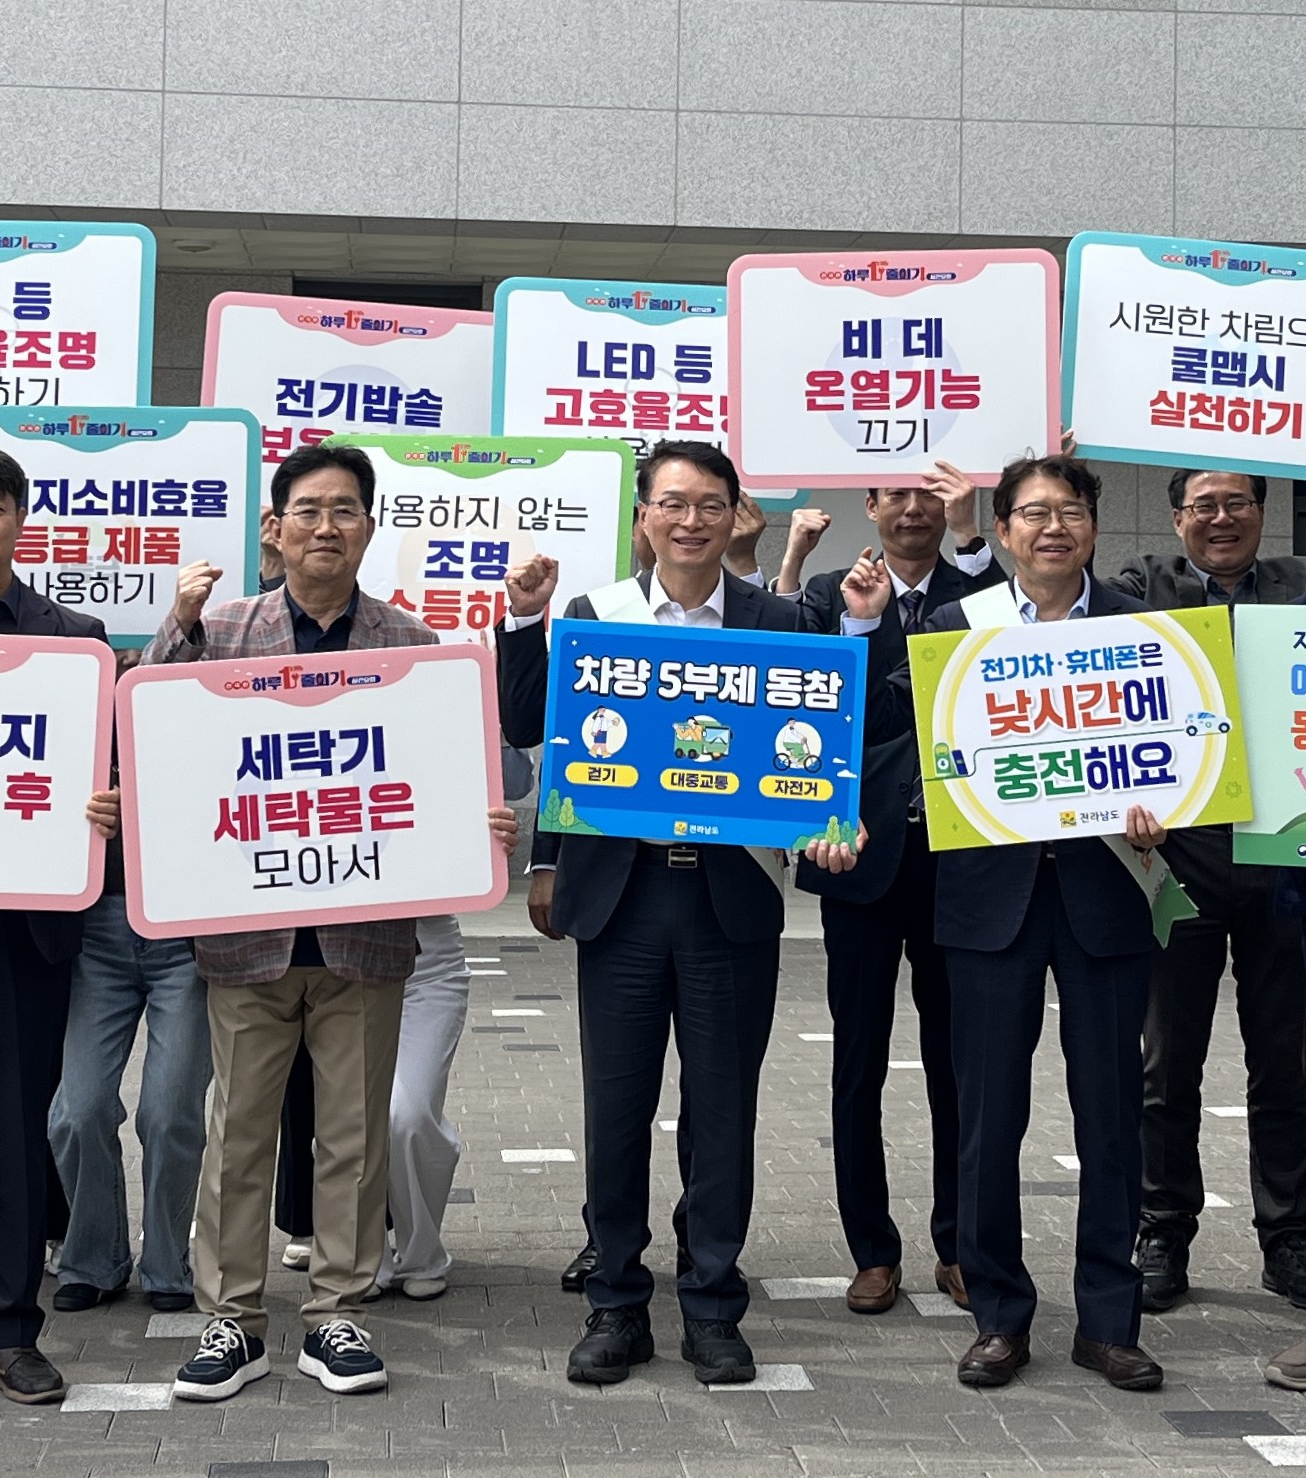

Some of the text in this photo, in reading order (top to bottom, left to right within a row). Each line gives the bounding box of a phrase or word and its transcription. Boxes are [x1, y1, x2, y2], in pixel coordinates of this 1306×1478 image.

[13, 281, 52, 320] 등
[1109, 301, 1210, 338] 시원한
[577, 341, 712, 383] LED 등
[1171, 345, 1286, 392] 쿨맵시
[276, 378, 443, 428] 전기밥솥
[544, 387, 727, 432] 고효율조
[805, 369, 981, 411] 온열기능
[1149, 389, 1303, 439] 실천하기
[856, 418, 929, 453] 끄기
[24, 479, 228, 518] 지소비효율
[518, 496, 588, 532] 않는
[104, 526, 181, 565] 제품
[424, 540, 510, 581] 조명
[30, 572, 155, 605] 사용하기
[574, 655, 844, 710] 차량 5부제 동참
[985, 676, 1169, 737] 낮시간에
[237, 726, 385, 782] 세탁기
[993, 741, 1177, 800] 충전해요
[4, 772, 52, 820] 후
[587, 766, 818, 797] 걷기 대중교통 자전거
[214, 782, 414, 842] 세탁물은
[689, 824, 720, 835] 전라남도
[1079, 810, 1120, 824] 전라남도
[252, 841, 382, 890] 모아서
